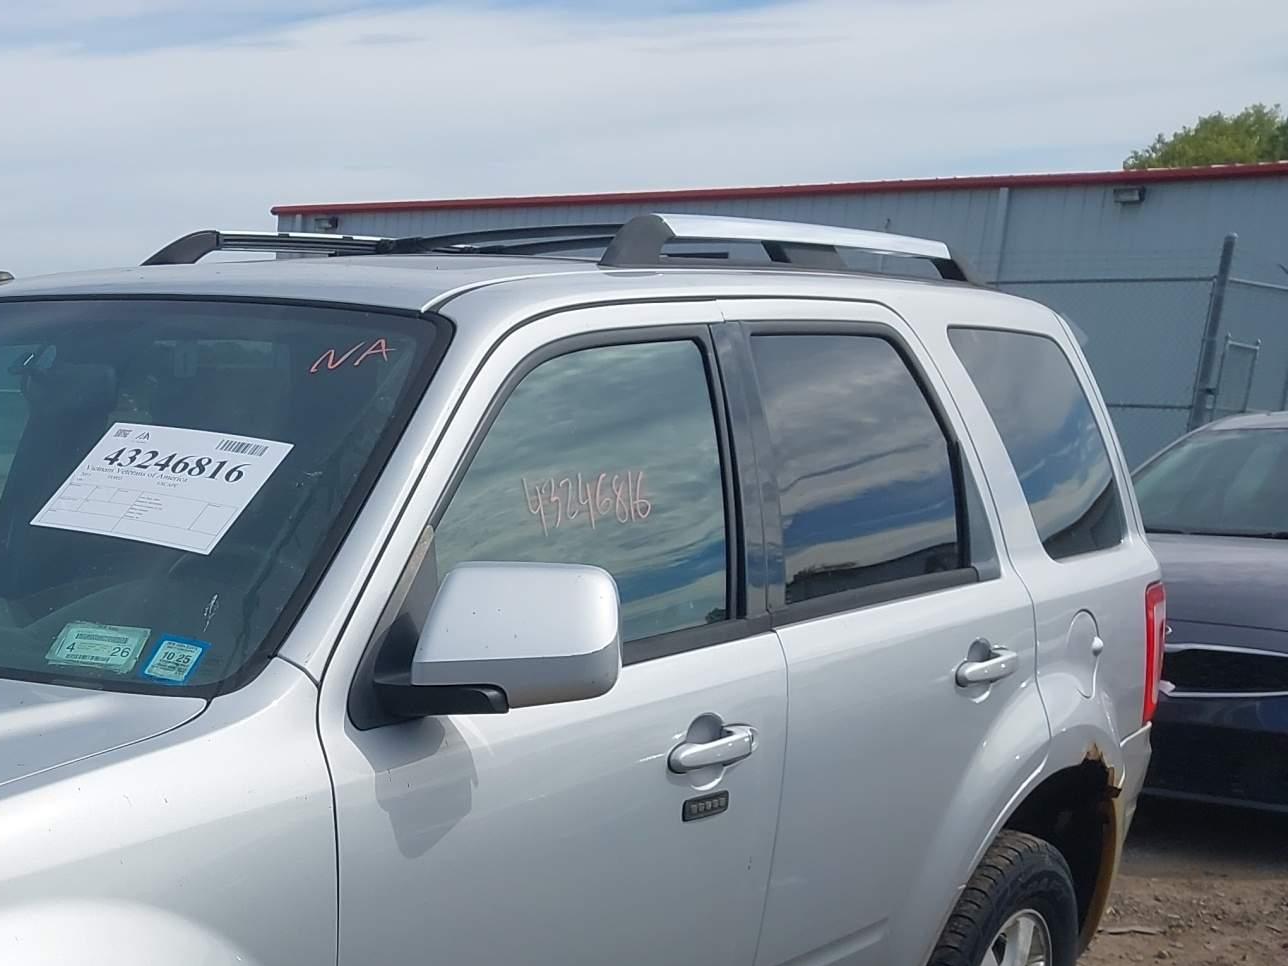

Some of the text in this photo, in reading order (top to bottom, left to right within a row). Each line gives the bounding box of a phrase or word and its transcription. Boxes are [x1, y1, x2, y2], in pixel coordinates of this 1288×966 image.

[104, 447, 251, 483] 43246816
[521, 471, 651, 537] 43246816
[66, 642, 131, 658] 4 26
[162, 651, 175, 660] 10
